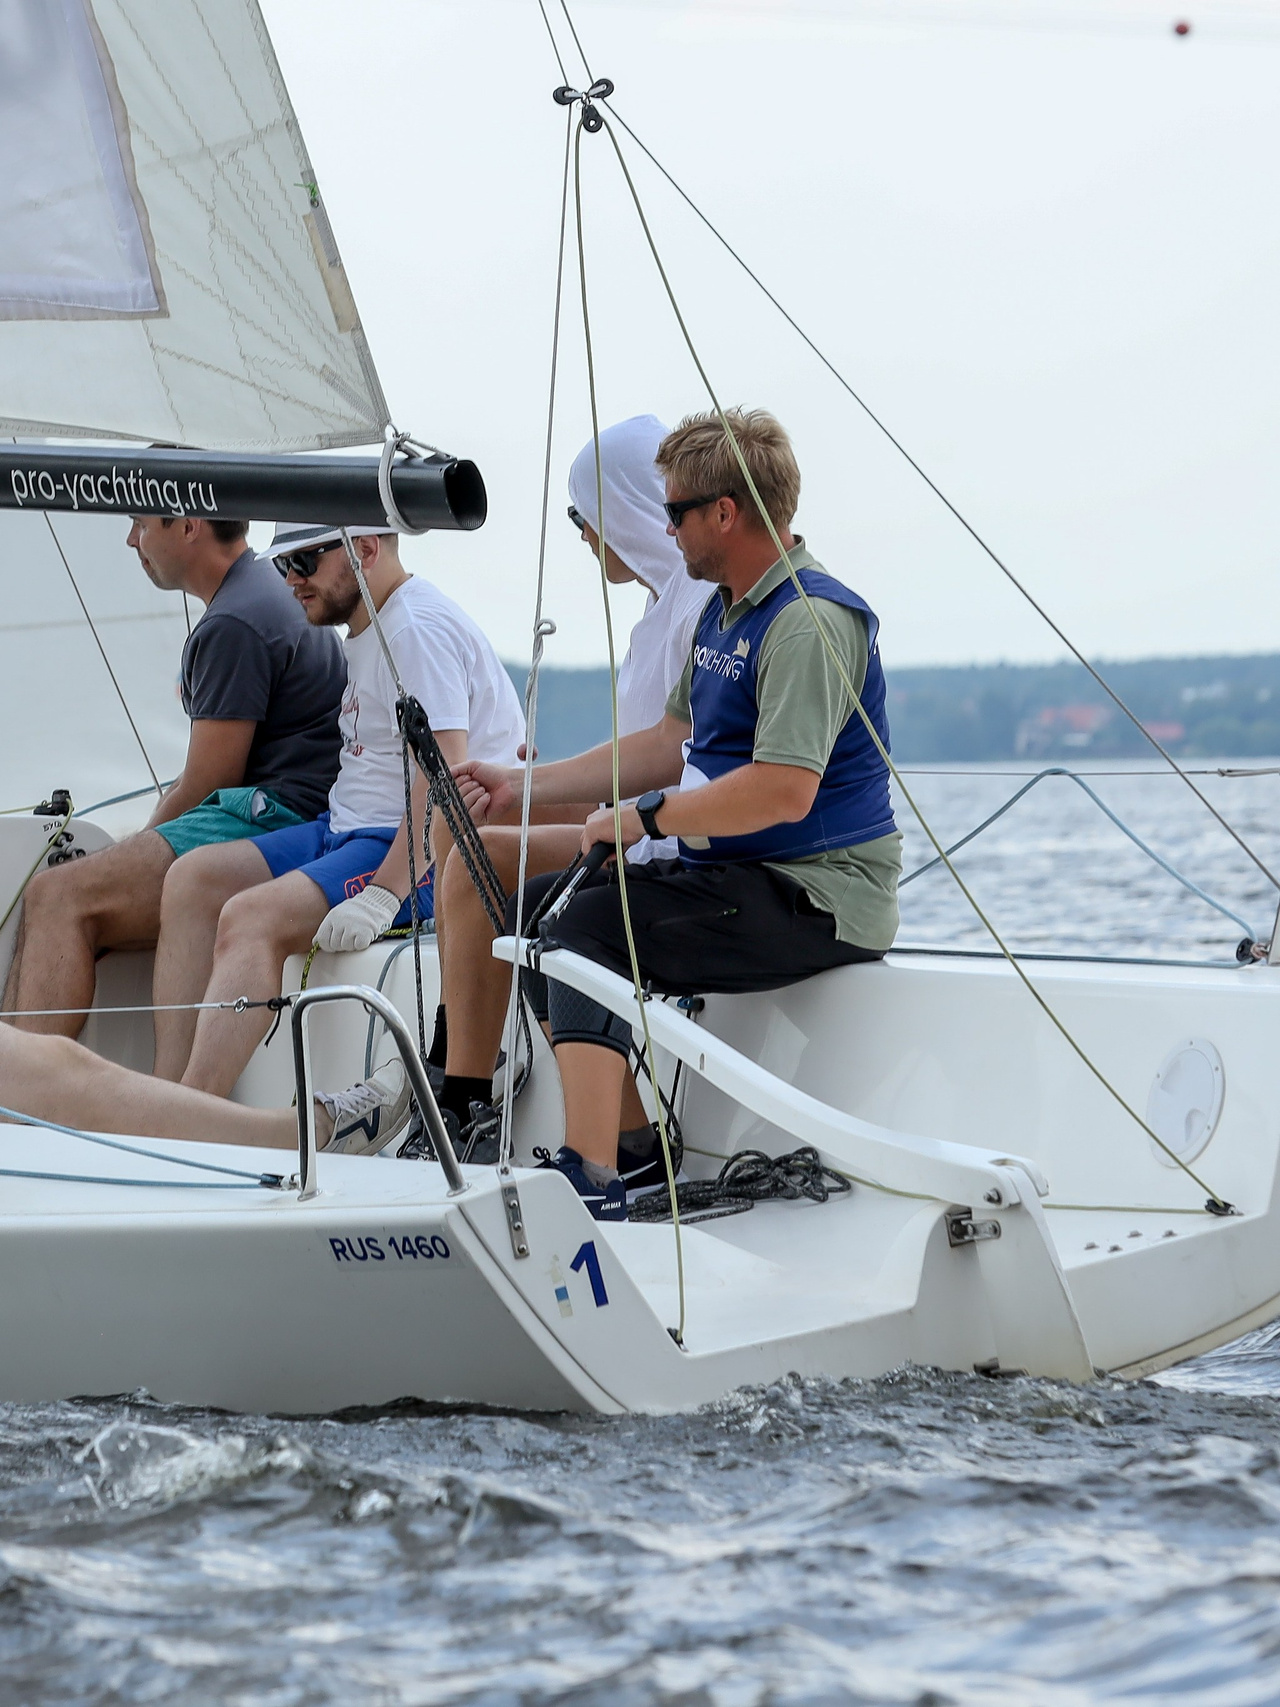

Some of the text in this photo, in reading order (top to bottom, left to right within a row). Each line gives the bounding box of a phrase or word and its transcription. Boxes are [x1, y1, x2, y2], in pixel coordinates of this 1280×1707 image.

[11, 465, 219, 517] pro-yachting.ru
[328, 1234, 451, 1262] RUS 1460
[569, 1239, 609, 1309] 1
